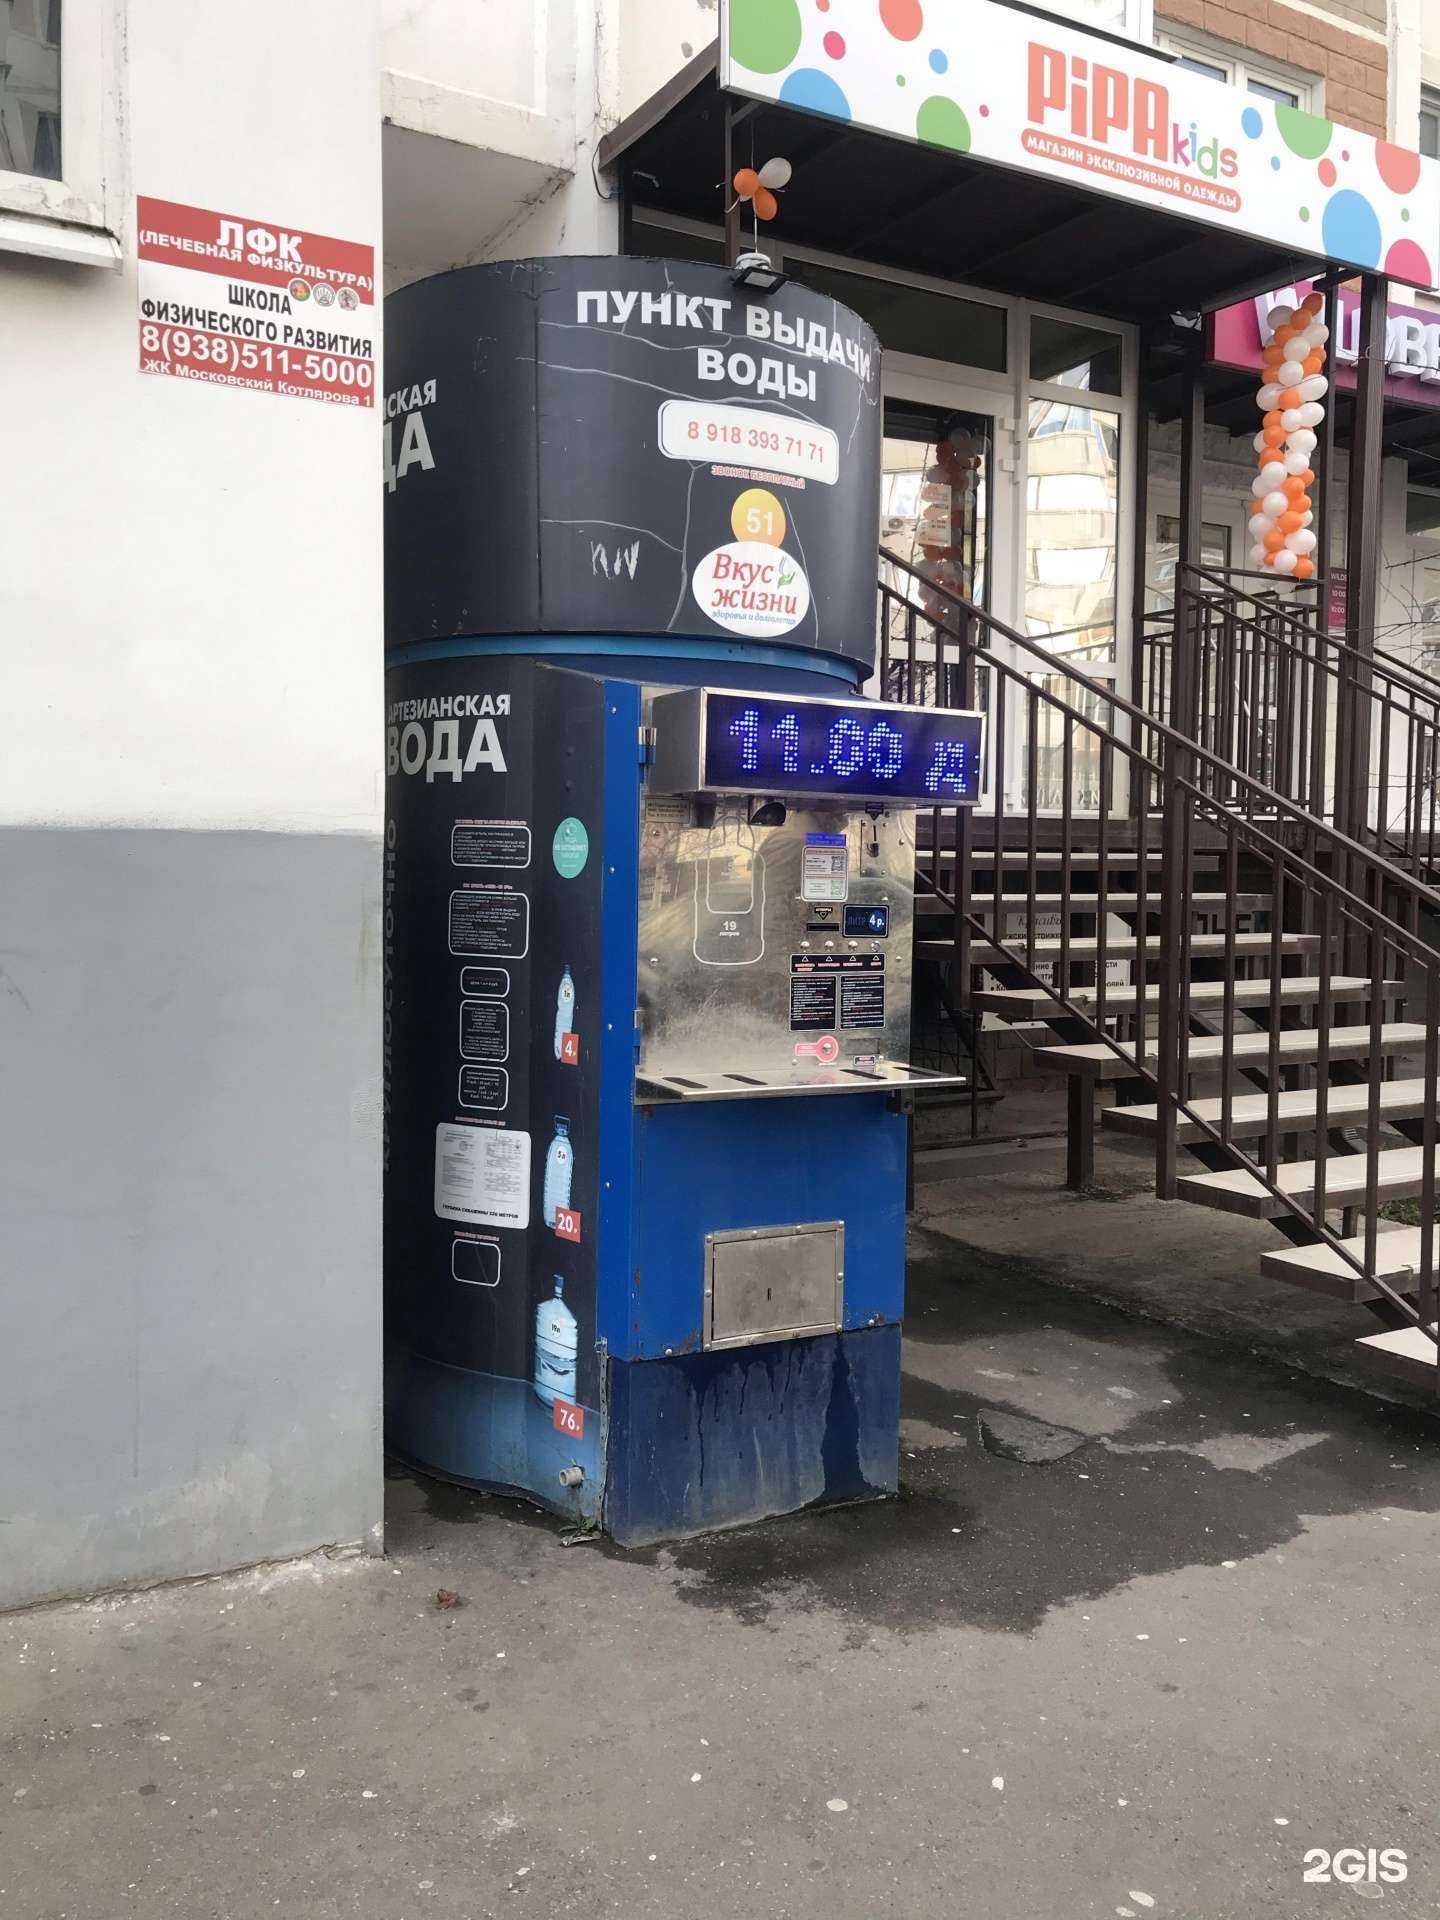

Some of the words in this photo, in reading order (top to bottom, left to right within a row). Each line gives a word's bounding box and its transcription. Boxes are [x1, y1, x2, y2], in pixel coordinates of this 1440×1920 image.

[1027, 135, 1084, 164] МАГАЗИН
[1087, 149, 1181, 191] ЭКСКЛЮЗИВНОЙ
[1184, 182, 1237, 208] ОДЕЖДЫ
[1173, 122, 1239, 179] kids
[139, 229, 242, 263] (ЛЕЧЕБНАЯ
[247, 252, 374, 291] ФИЗКУЛЬТУРА)
[216, 219, 303, 262] ЛФК
[228, 284, 293, 315] ШКОЛА
[141, 299, 278, 341] ФИЗИЧЕСКОГО
[283, 326, 372, 358] РАЗВИТИЯ
[577, 290, 732, 331] ПУНКТ
[746, 304, 872, 383] ВЫДАЧИ
[142, 325, 372, 388] 8(938)511-5000
[697, 348, 816, 401] ВОДЫ
[144, 358, 170, 374] ЖК
[175, 363, 273, 391] Московский
[278, 382, 359, 405] Котлярова
[365, 394, 371, 407] 1
[688, 421, 699, 439] 8
[707, 423, 742, 444] 918
[748, 429, 779, 450] 393
[785, 436, 802, 457] 71
[808, 442, 824, 463] 71
[745, 508, 773, 536] 51
[712, 553, 775, 589] Вкус
[711, 588, 797, 614] жизни
[388, 694, 511, 722] АРТЕЗИАНСКАЯ
[387, 719, 508, 783] ВОДА
[729, 709, 903, 780] 11.00
[723, 920, 737, 931] 19
